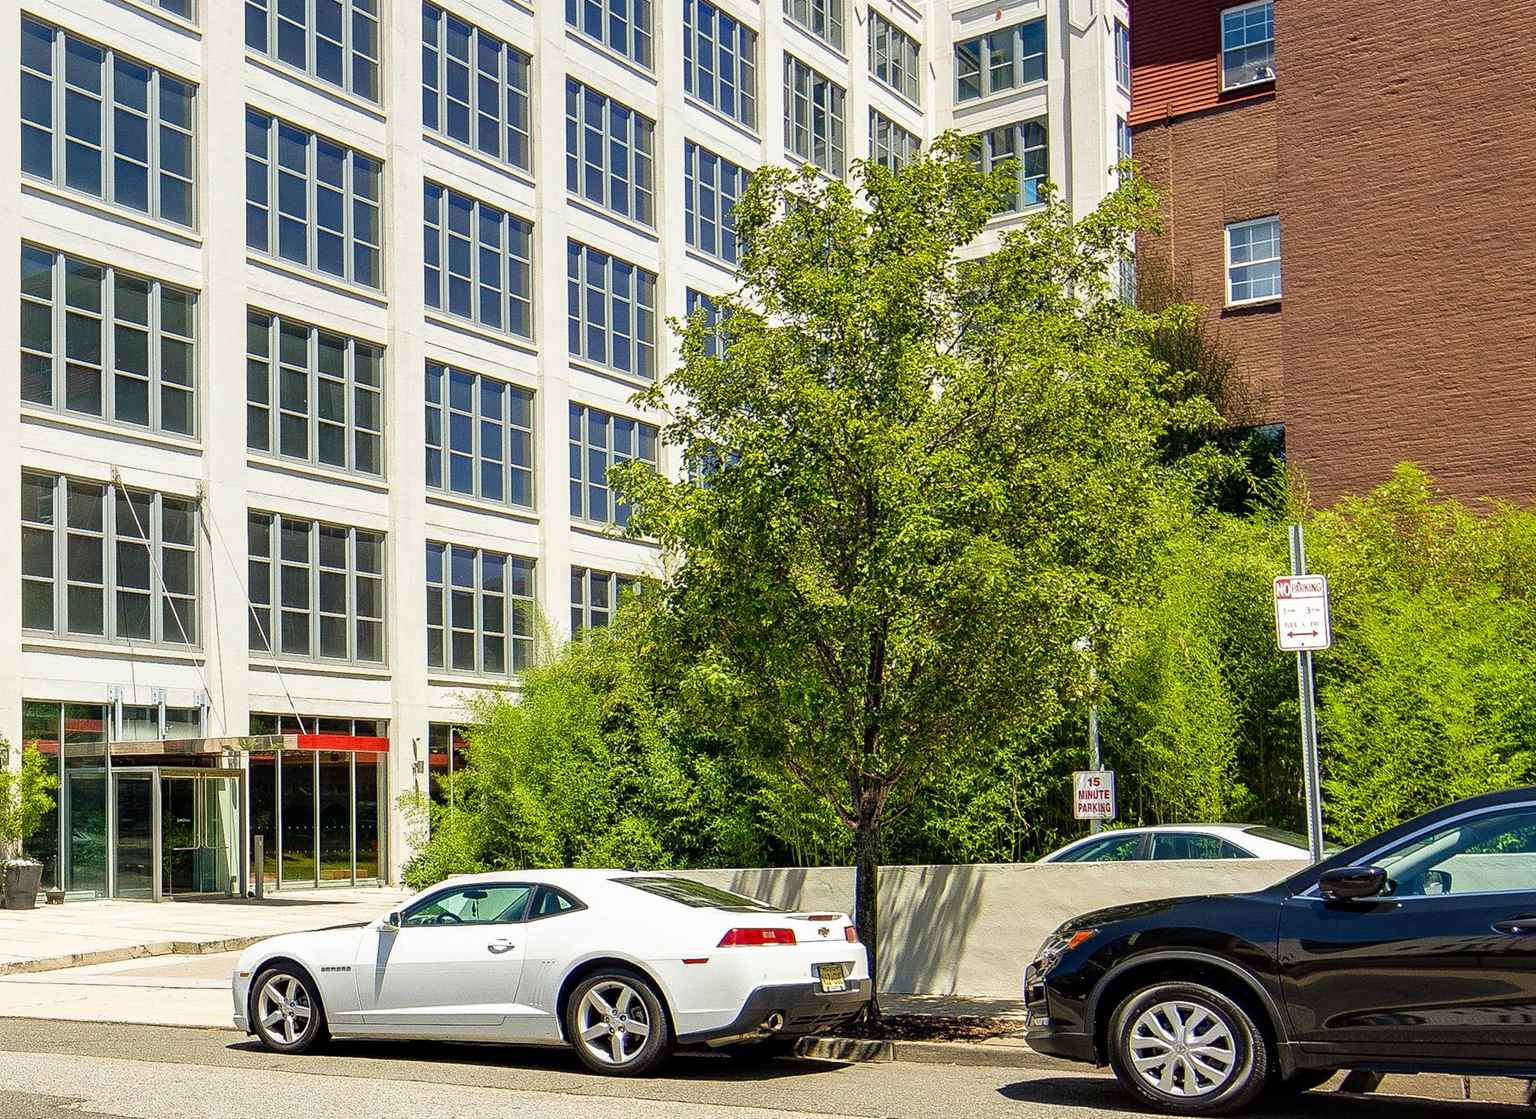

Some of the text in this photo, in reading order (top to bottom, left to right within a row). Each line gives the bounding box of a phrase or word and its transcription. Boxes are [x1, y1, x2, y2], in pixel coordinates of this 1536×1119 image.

[1276, 581, 1322, 597] NO PARKING
[1088, 777, 1101, 787] 15
[1078, 789, 1110, 800] MINUTE
[1078, 802, 1111, 813] PARKING
